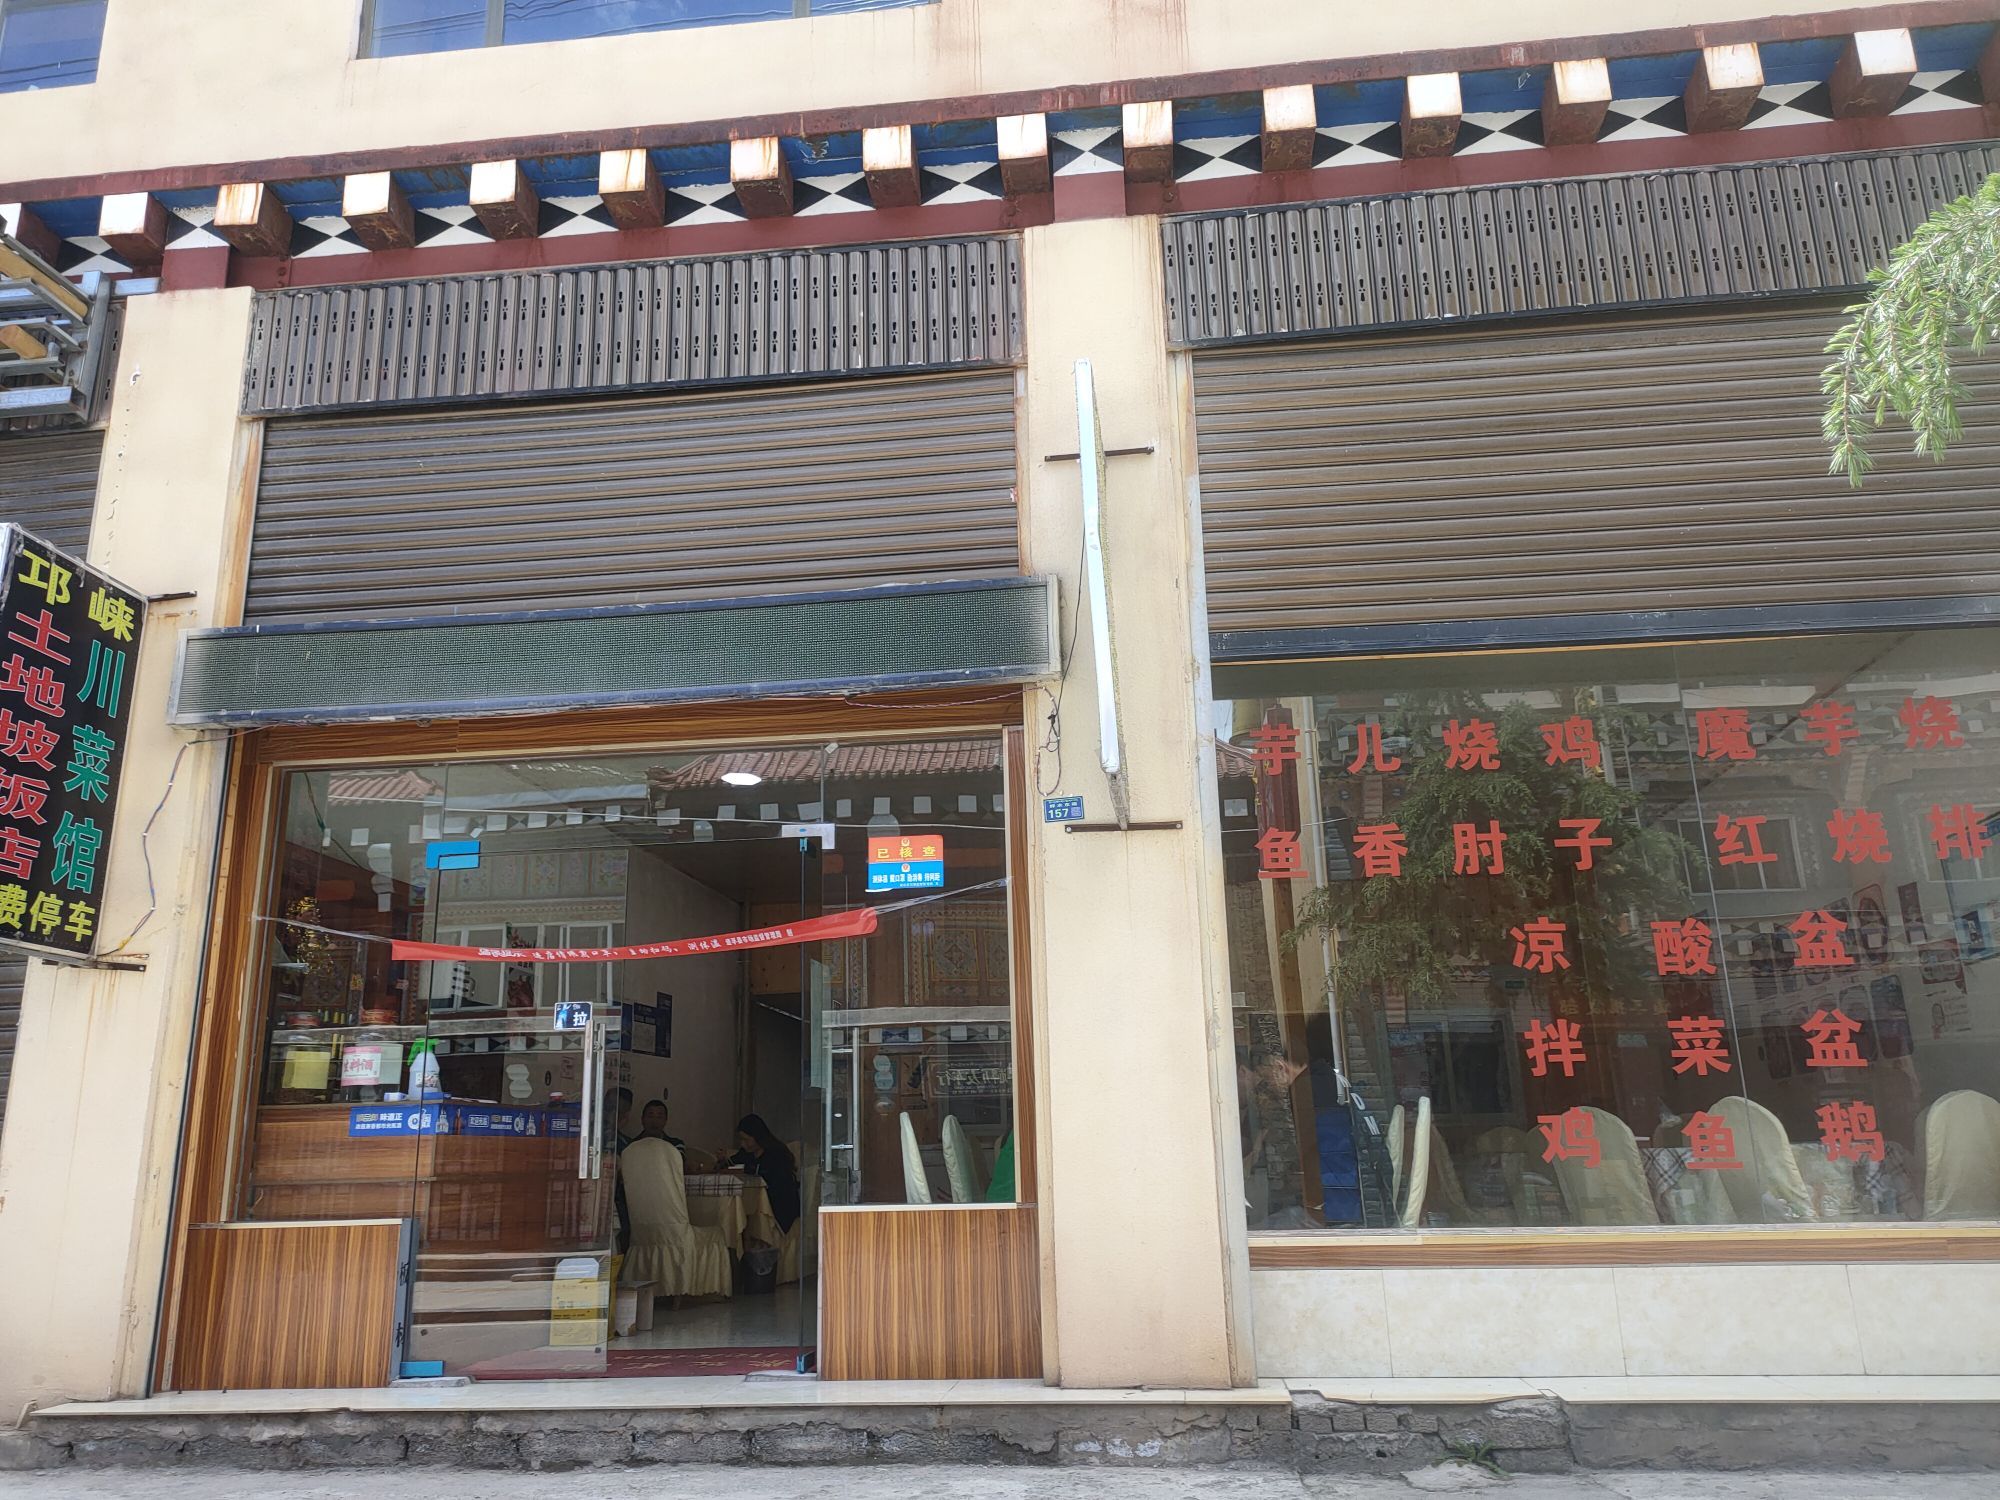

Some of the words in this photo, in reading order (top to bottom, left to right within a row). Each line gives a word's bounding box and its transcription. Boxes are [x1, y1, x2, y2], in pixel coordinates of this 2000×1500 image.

[0, 609, 71, 880] 土地坡饭店
[53, 639, 125, 895] 川菜馆
[1252, 716, 1601, 777] 芋儿烧鸡
[1048, 808, 1069, 819] 157
[1256, 818, 1612, 879] 鱼香肘子
[1713, 803, 1993, 866] 红烧排
[877, 845, 937, 859] 已核查
[0, 883, 96, 942] 费停车
[573, 1011, 588, 1027] 拉
[1511, 916, 1602, 1168] 凉拌鸡
[1650, 918, 1744, 1171] 酸菜鱼
[1788, 909, 1886, 1163] 盆盆鹅
